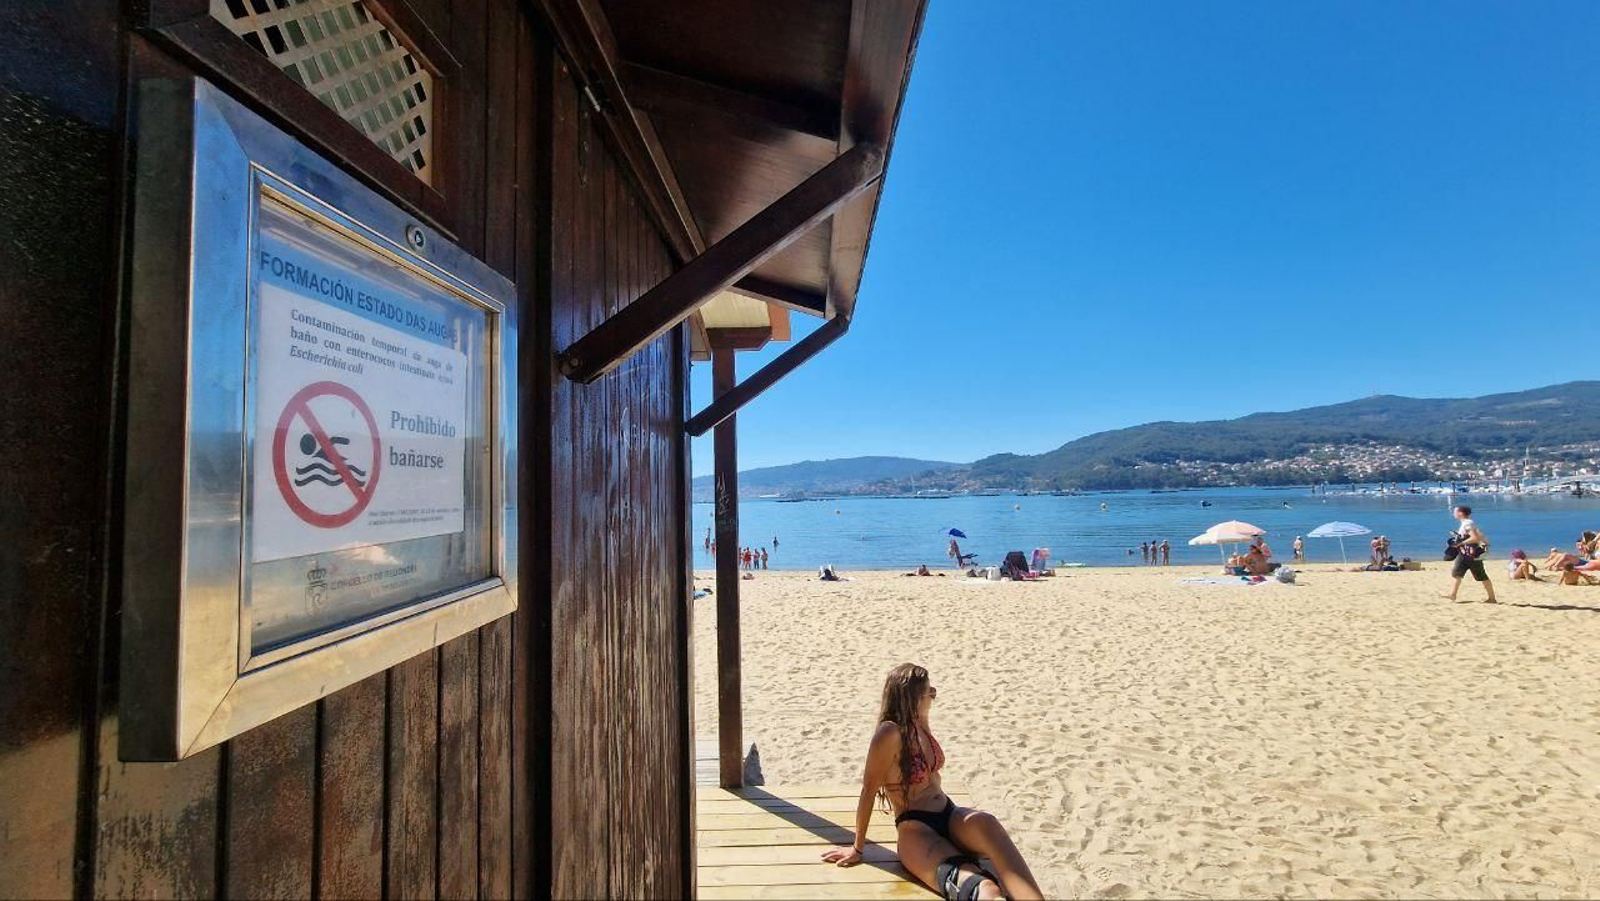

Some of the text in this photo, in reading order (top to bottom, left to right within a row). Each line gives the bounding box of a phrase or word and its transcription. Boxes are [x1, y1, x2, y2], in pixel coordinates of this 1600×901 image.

[357, 291, 404, 323] ESTADO
[405, 310, 426, 332] DAS
[290, 326, 318, 345] baño
[323, 339, 341, 352] con
[346, 345, 396, 368] enterococos
[291, 309, 366, 343] Contaminación
[371, 336, 407, 357] temporal
[290, 345, 364, 376] Escherichia coli
[390, 409, 456, 438] Prohibido
[389, 446, 444, 469] bañarse
